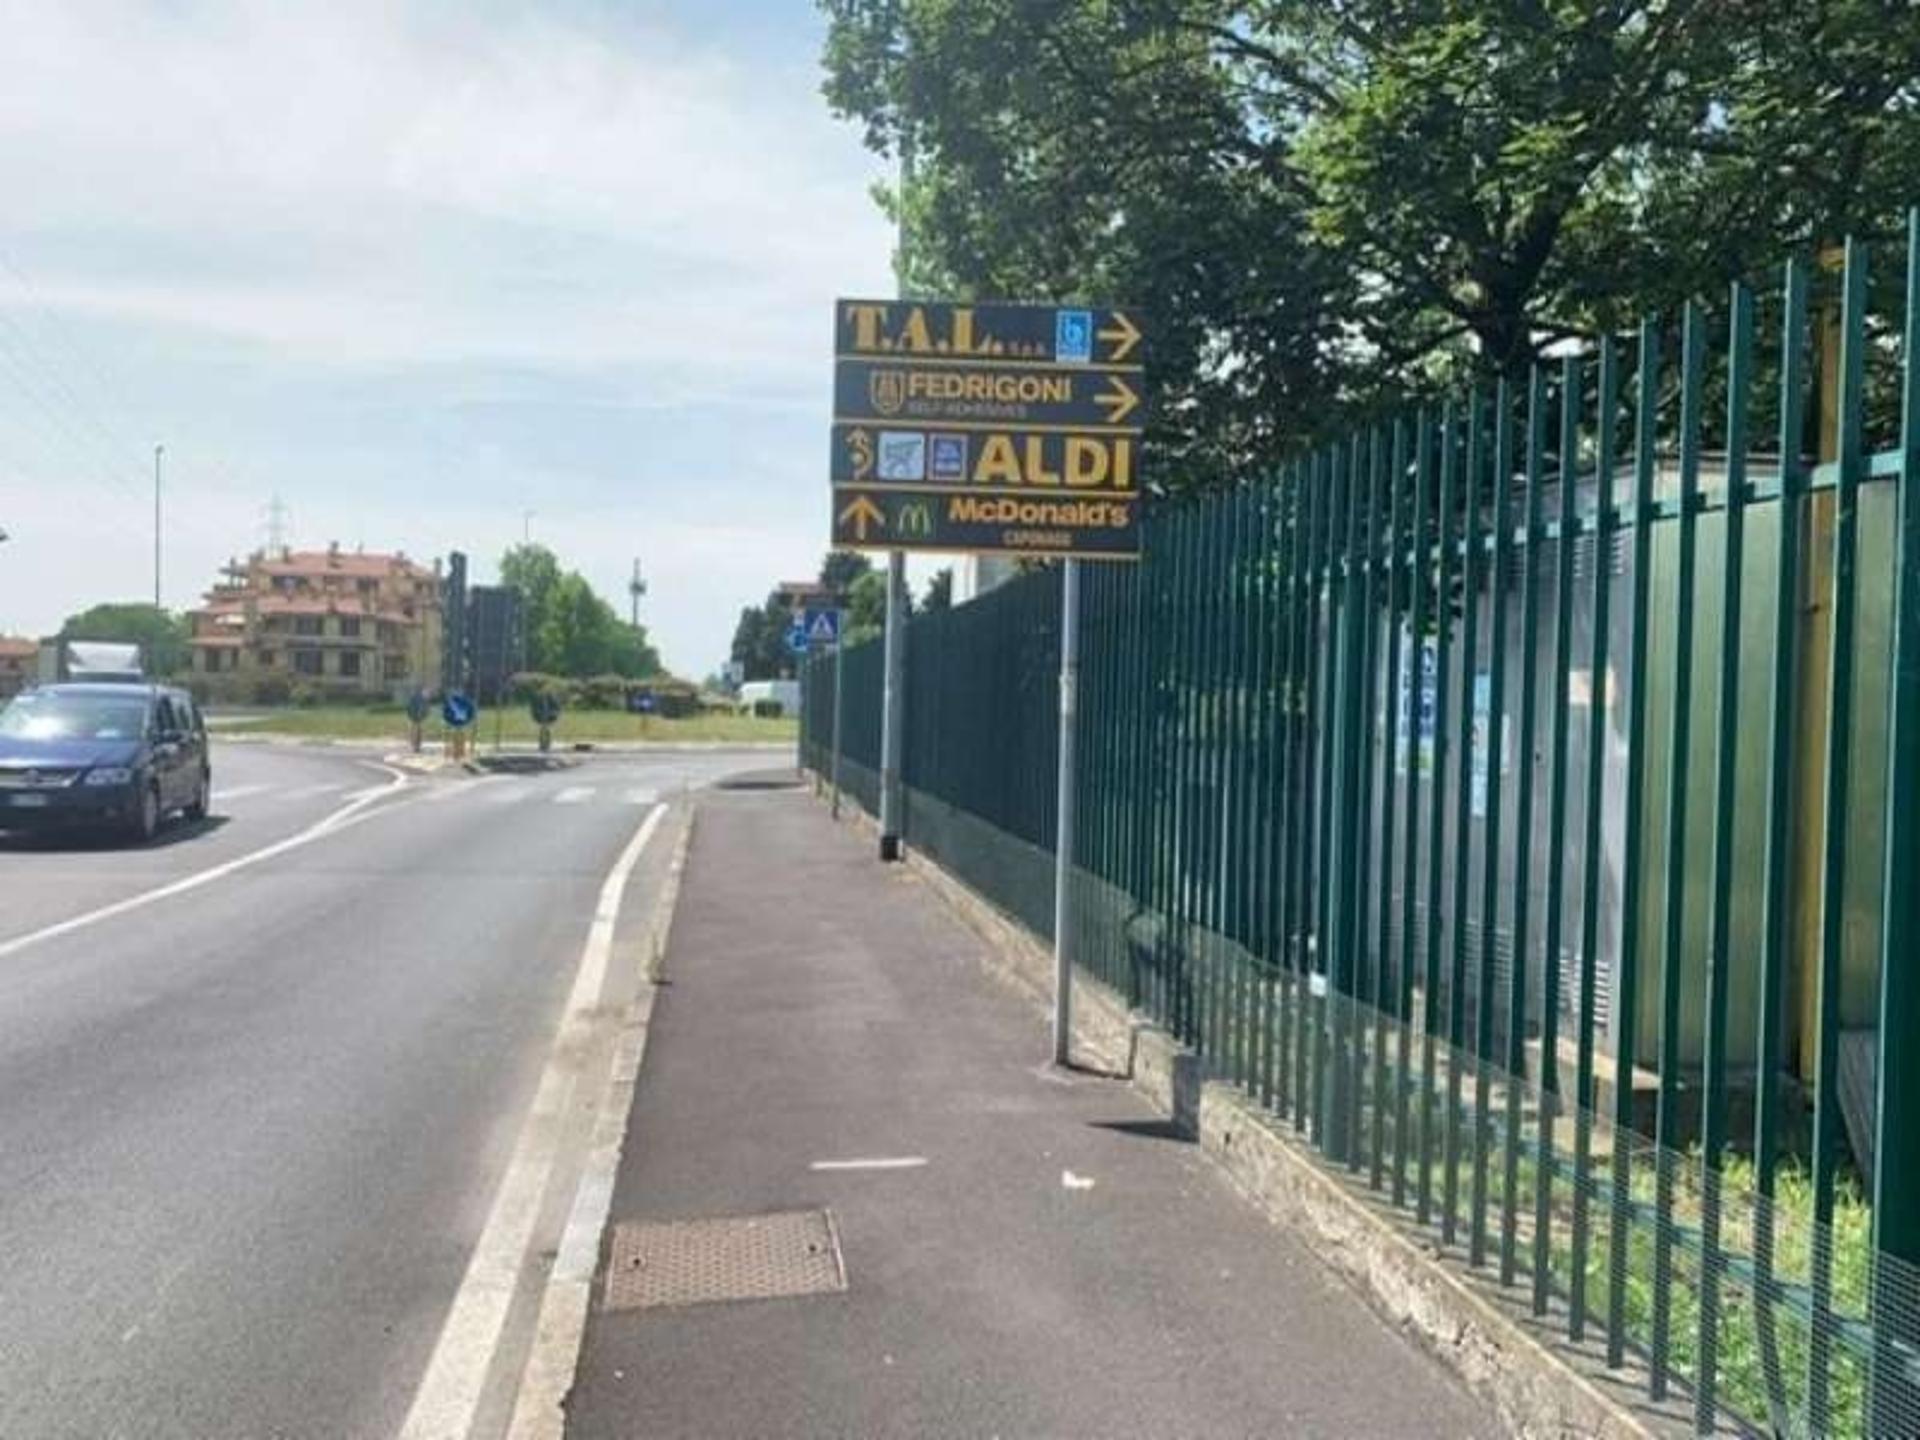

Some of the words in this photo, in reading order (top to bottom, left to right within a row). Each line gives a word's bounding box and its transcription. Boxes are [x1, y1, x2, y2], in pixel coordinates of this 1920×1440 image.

[908, 371, 1072, 403] FEDRIGONI
[973, 433, 1131, 488] ALDI
[949, 497, 1129, 528] McDonald's
